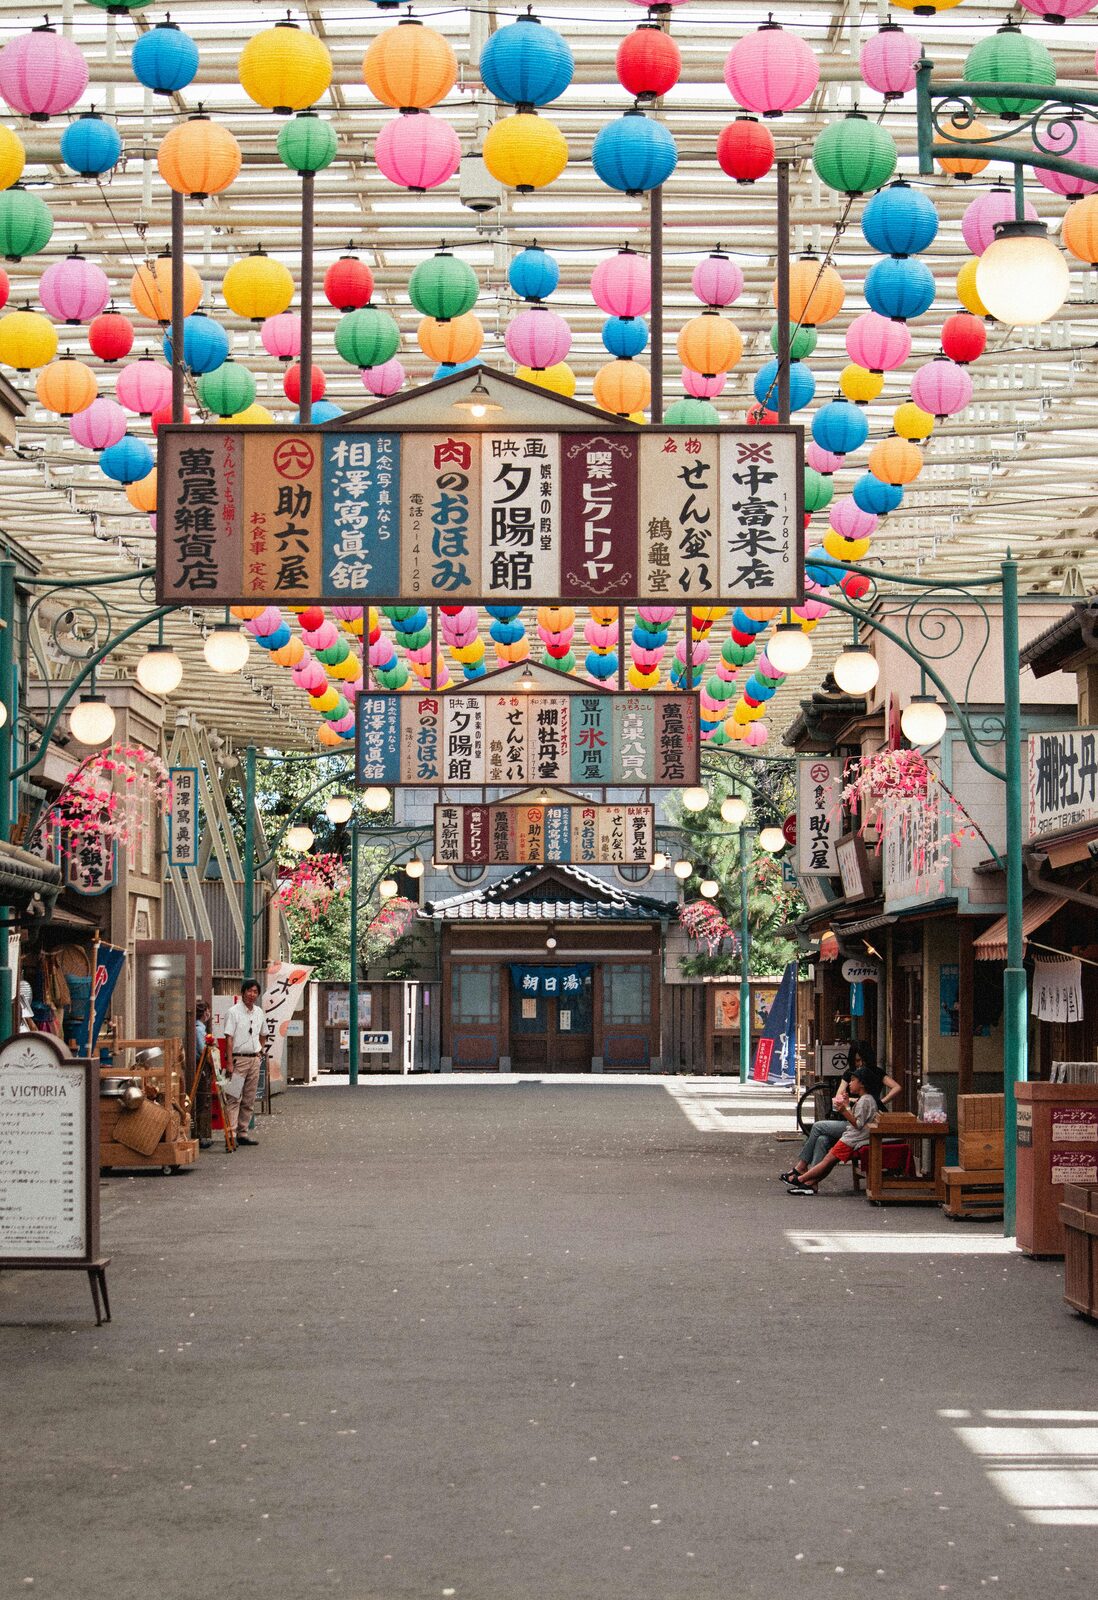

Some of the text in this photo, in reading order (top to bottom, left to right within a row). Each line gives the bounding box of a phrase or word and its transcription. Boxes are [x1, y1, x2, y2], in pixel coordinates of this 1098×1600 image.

[491, 438, 549, 459] 映画
[660, 436, 703, 454] 名物
[376, 438, 393, 541] 記念写真なら
[539, 463, 552, 551] 娯楽の殿堂
[248, 511, 268, 592] お食事 定食
[273, 484, 311, 592] 助六屋
[489, 463, 536, 591] 夕陽館
[449, 698, 480, 709] 映画
[448, 711, 472, 780] 夕陽館
[536, 708, 560, 779] 棚牡丹堂
[528, 823, 541, 860] 助六屋
[632, 816, 647, 861] 夢見堂
[809, 814, 831, 870] 助六屋
[522, 973, 579, 992] 朝日湯
[11, 1085, 67, 1097] VICTORIA
